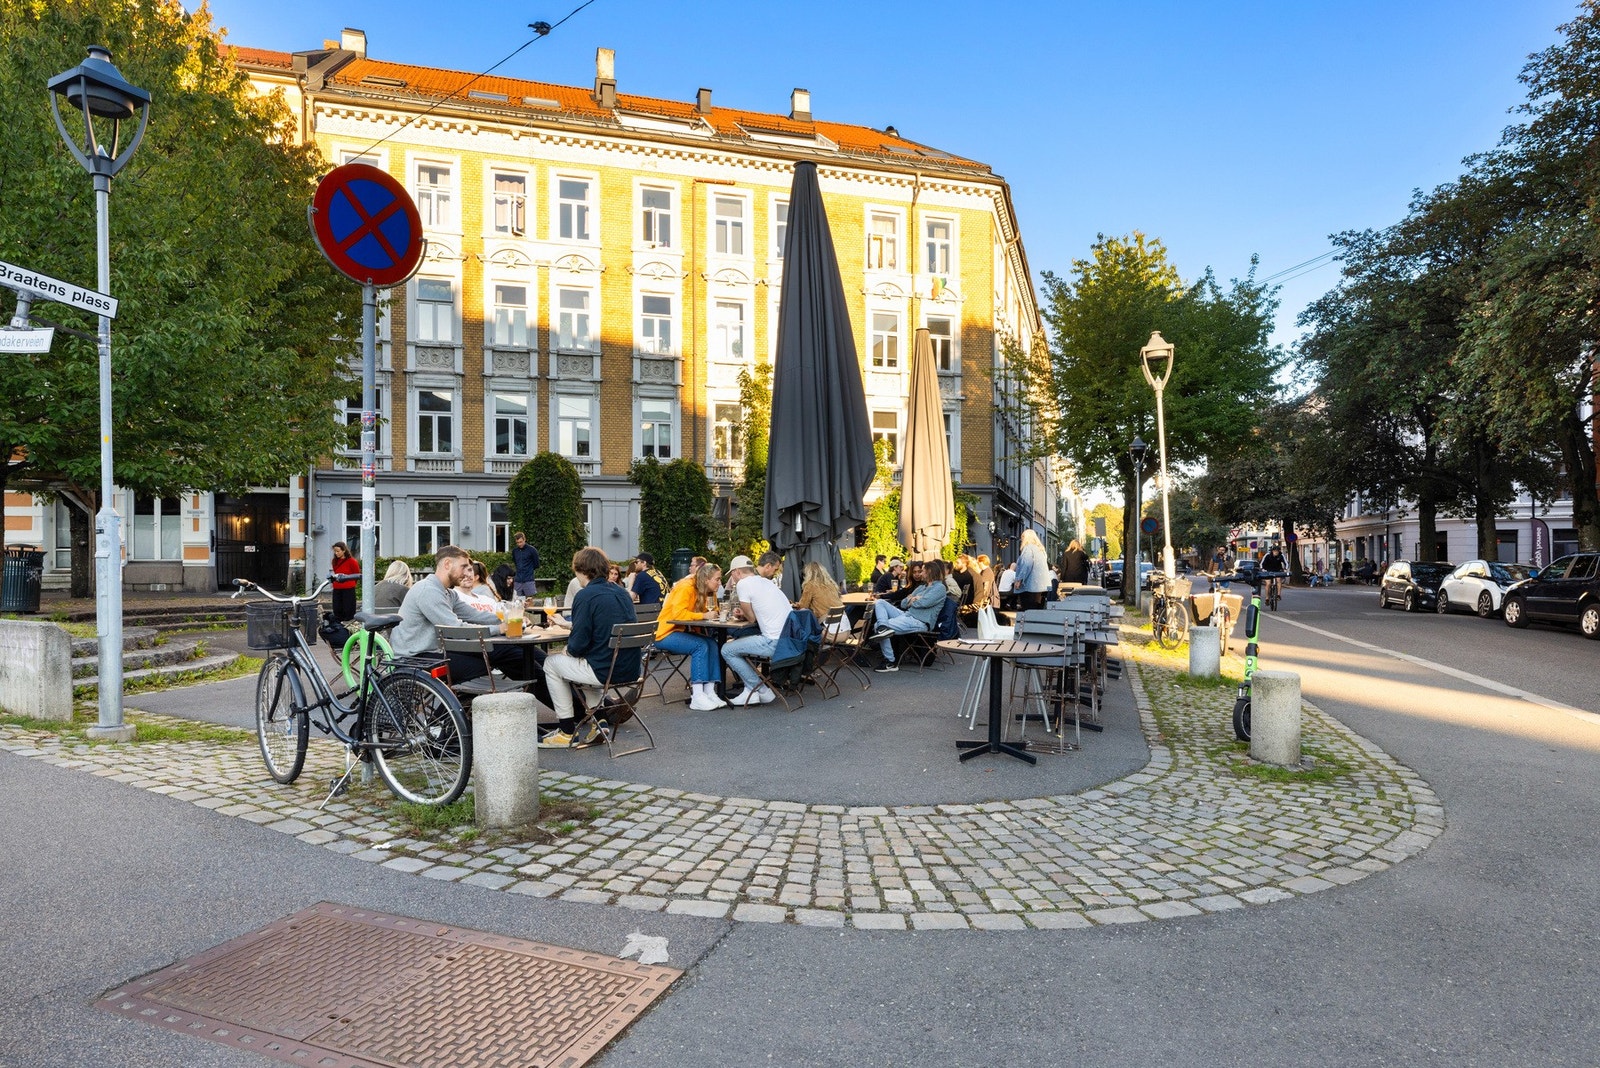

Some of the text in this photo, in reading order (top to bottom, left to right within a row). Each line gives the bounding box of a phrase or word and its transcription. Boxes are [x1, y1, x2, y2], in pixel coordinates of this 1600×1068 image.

[0, 265, 111, 311] Braatens plass
[0, 335, 44, 347] dakerveien
